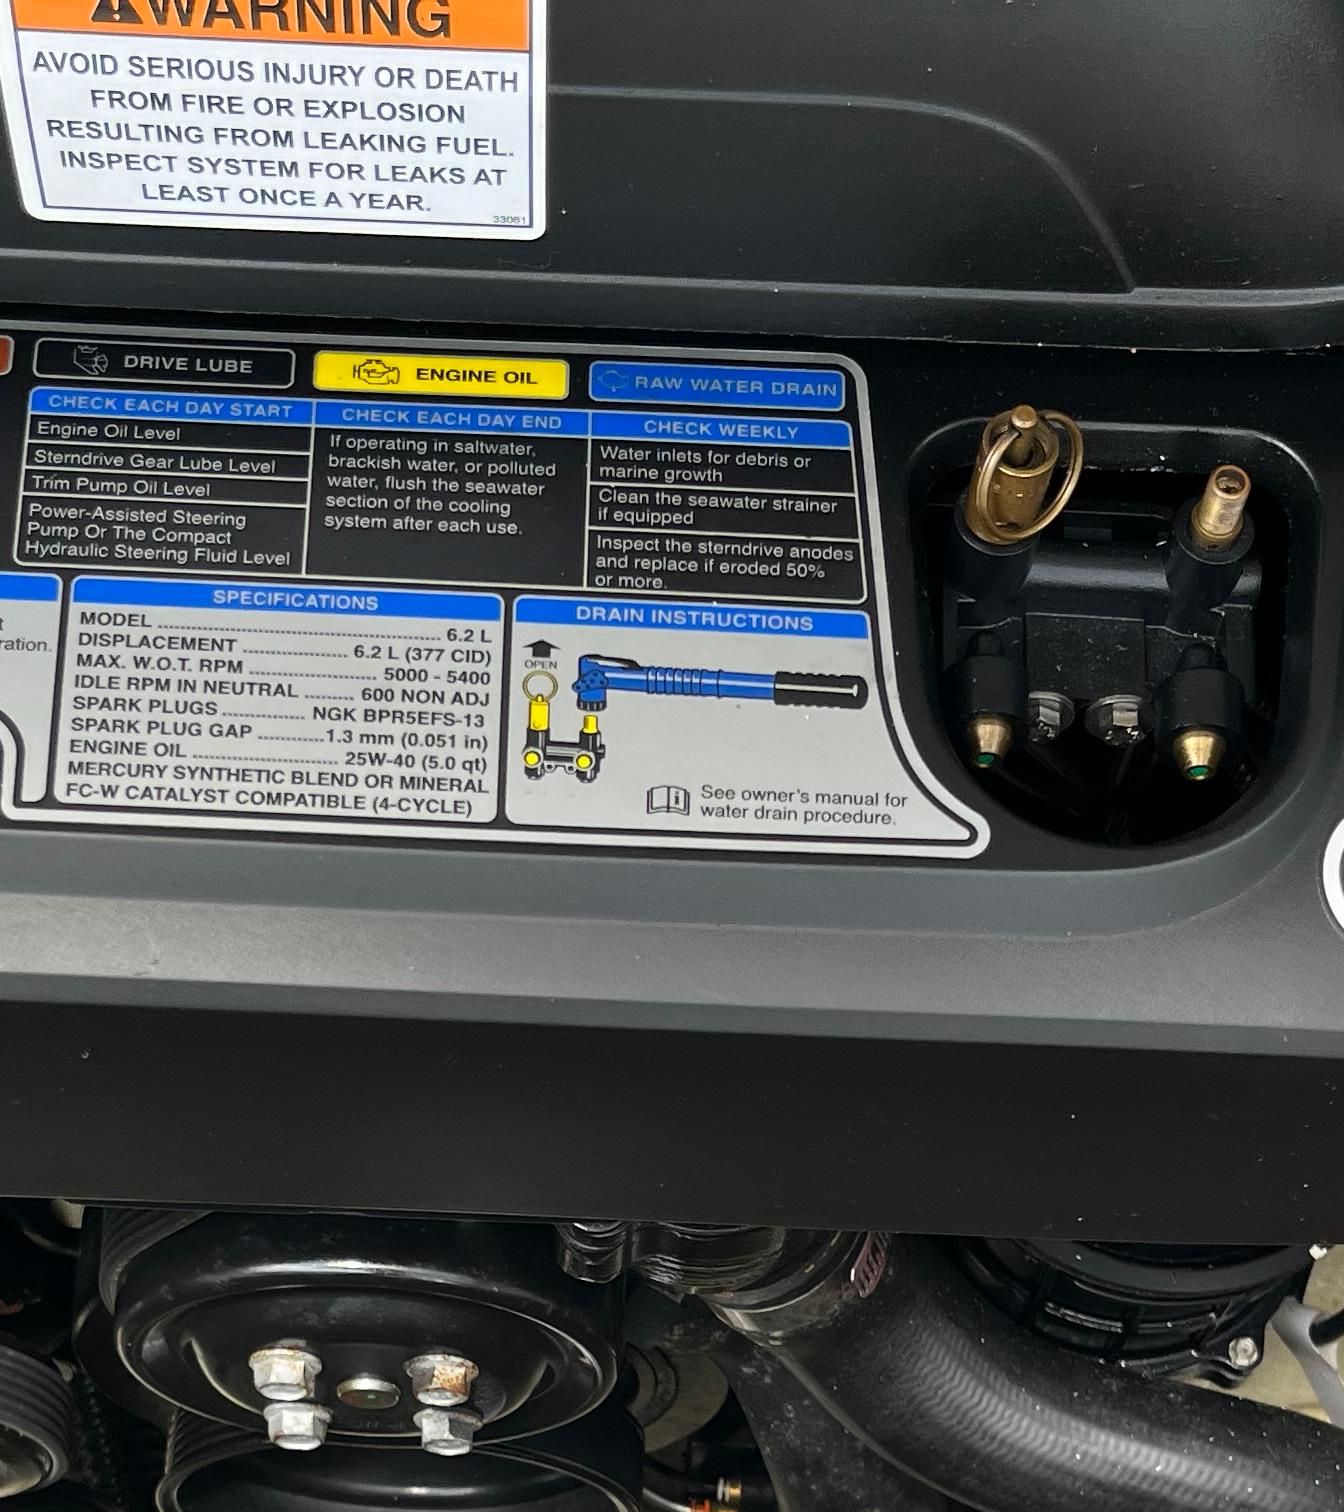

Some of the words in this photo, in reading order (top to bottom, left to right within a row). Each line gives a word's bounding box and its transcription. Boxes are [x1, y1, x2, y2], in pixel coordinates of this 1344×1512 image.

[151, 0, 452, 39] WARNING
[33, 50, 119, 77] AVOID
[128, 54, 255, 82] SERIOUS
[264, 60, 366, 87] INJURY
[374, 65, 416, 89] OR
[424, 67, 519, 93] DEATH
[91, 89, 172, 112] FROM
[182, 93, 244, 115] FIRE
[253, 96, 294, 117] OR
[303, 98, 466, 124] EXPLOSION
[46, 119, 204, 144] RESULTING
[213, 126, 294, 148] FROM
[303, 129, 426, 153] LEAKING
[436, 134, 515, 157] FUEL.
[60, 150, 178, 173] INSPECT
[188, 155, 300, 178] SYSTEM
[308, 160, 364, 181] FOR
[374, 162, 466, 185] LEAKS
[473, 166, 508, 187] AT
[142, 182, 230, 204] LEAST
[238, 186, 316, 208] ONCE
[323, 189, 343, 209] A
[348, 190, 431, 212] YEAR.
[124, 355, 188, 371] DRIVE
[196, 358, 253, 374] LUBE
[416, 368, 497, 383] ENGINE
[503, 371, 538, 385] OIL
[635, 375, 684, 390] RAW
[691, 378, 763, 394] WATER
[772, 381, 837, 397] DRAIN
[48, 394, 117, 410] CHECK
[124, 397, 179, 413] EACH
[185, 400, 224, 415] DAY
[230, 402, 293, 419] START
[342, 408, 410, 424] CHECK
[417, 411, 471, 426] EACH
[478, 413, 516, 428] DAY
[522, 415, 562, 430] END
[37, 421, 98, 440] Engine
[104, 424, 128, 438] Oil
[134, 425, 181, 441] Level
[644, 420, 712, 436] CHECK
[719, 423, 799, 439] WEEKLY
[330, 434, 341, 448] If
[346, 435, 428, 455] operating
[434, 439, 449, 453] in
[454, 439, 536, 458] saltwater,
[600, 445, 651, 462] Water
[656, 447, 702, 464] inlets
[708, 449, 730, 465] for
[735, 451, 788, 468] debris
[794, 457, 811, 469] or
[34, 449, 124, 467] Sterndrive
[130, 454, 174, 469] Gear
[180, 456, 223, 471] Lube
[229, 458, 275, 474] Level
[212, 589, 379, 611] SPECIFICATIONS
[80, 611, 153, 629] MODEL
[446, 628, 475, 643] 6.2
[480, 629, 492, 643] L
[576, 605, 645, 624] DRAIN
[651, 608, 813, 632] INSTRUCTIONS
[78, 632, 238, 653] DISPLACEMENT
[353, 645, 383, 659] 6.2
[388, 646, 400, 660] L
[404, 646, 445, 663] (377
[450, 648, 492, 667] CID)
[524, 658, 558, 670] OPEN
[72, 695, 143, 714] SPARK
[149, 699, 219, 717] PLUGS
[312, 706, 357, 723] NGK
[363, 708, 485, 728] BPR5EFS-13
[700, 784, 735, 801] See
[741, 787, 809, 805] owner's
[815, 790, 880, 807] manual
[885, 792, 908, 809] for
[700, 805, 748, 821] water
[754, 805, 798, 823] drain
[803, 808, 897, 827] procedure.
